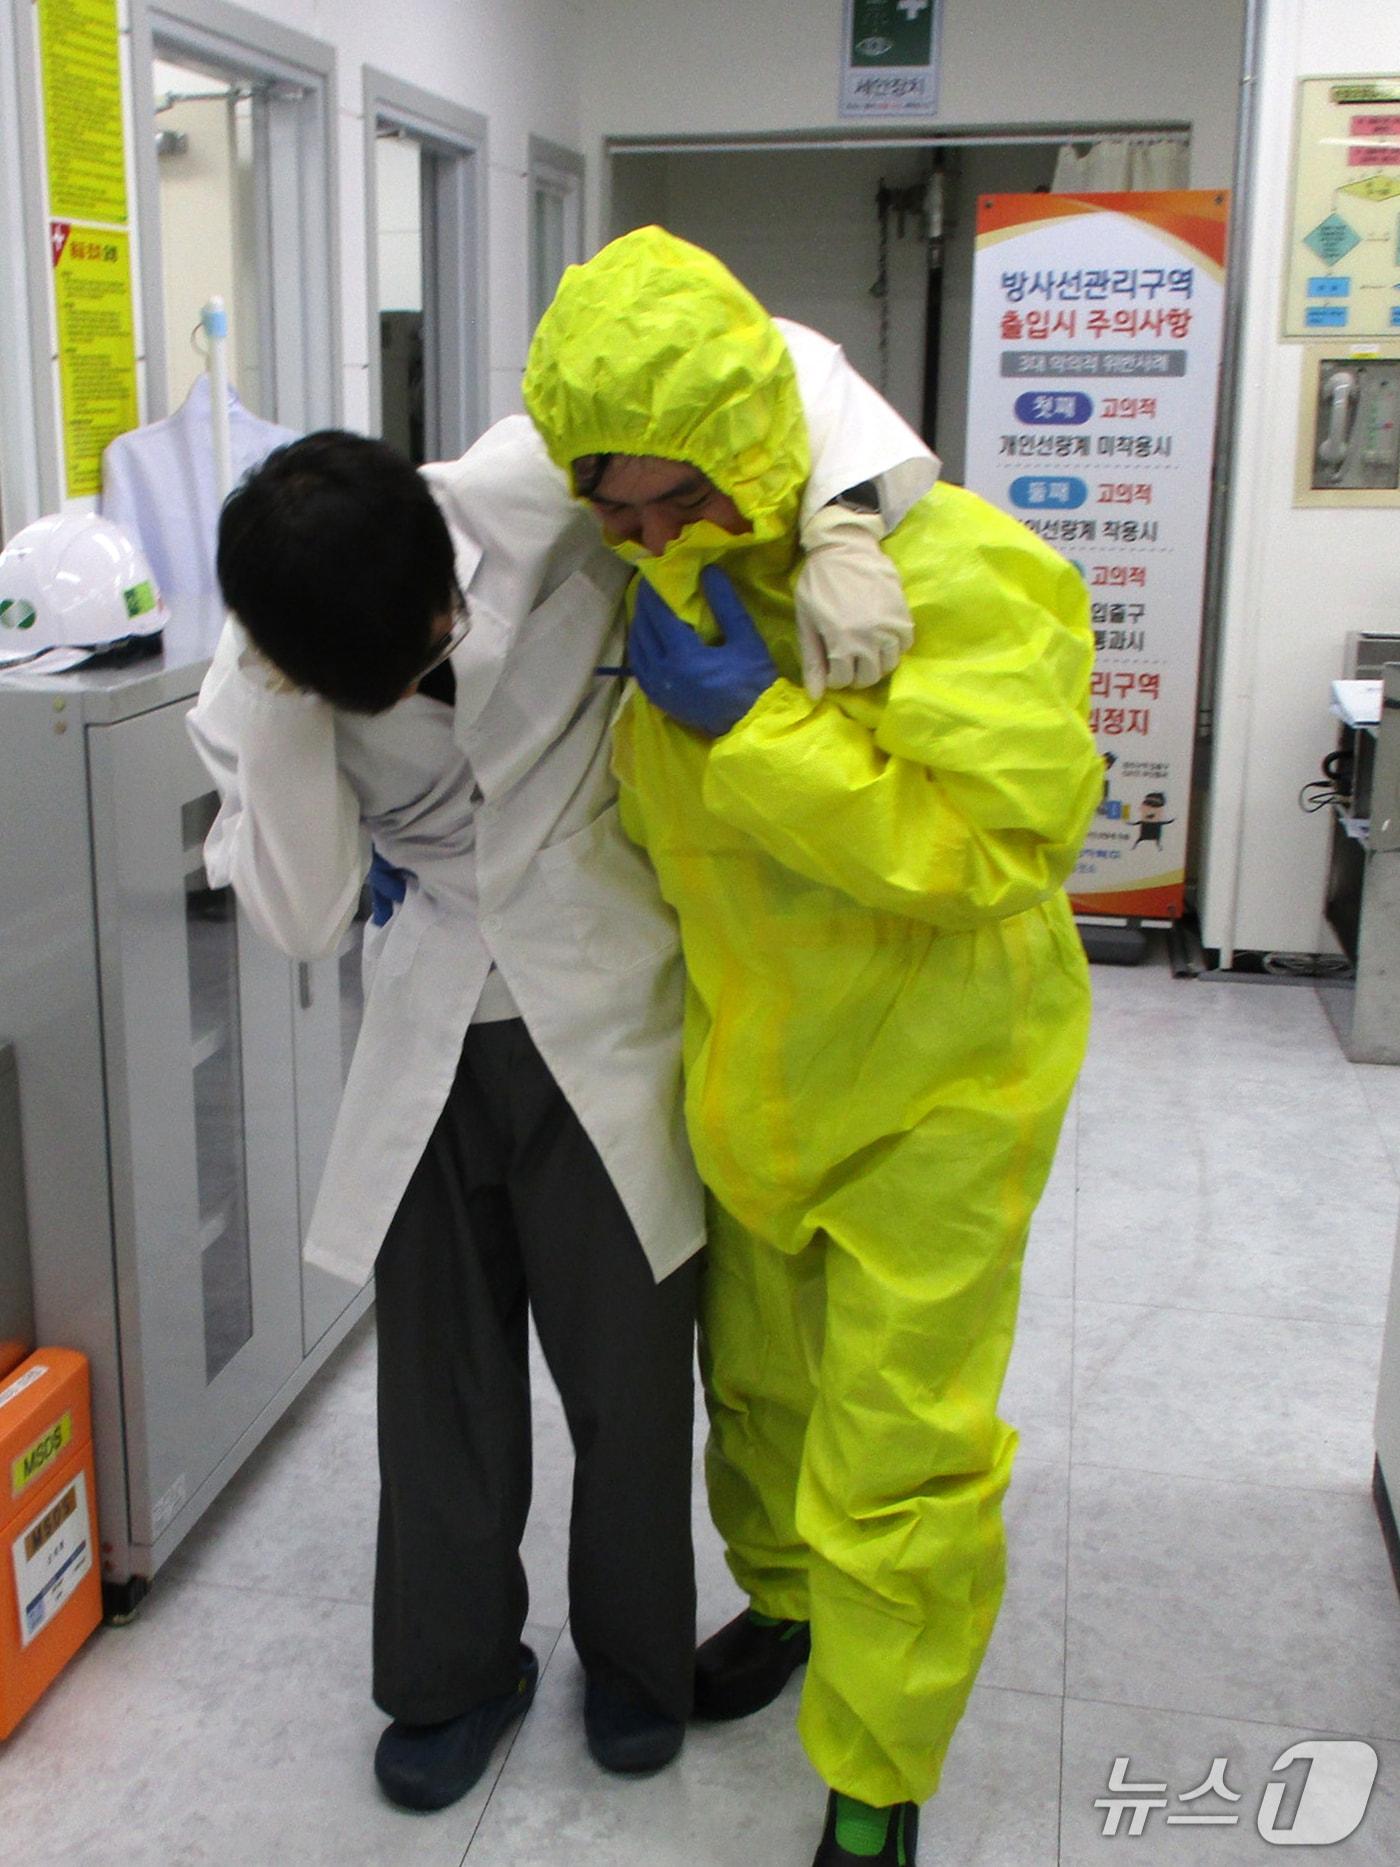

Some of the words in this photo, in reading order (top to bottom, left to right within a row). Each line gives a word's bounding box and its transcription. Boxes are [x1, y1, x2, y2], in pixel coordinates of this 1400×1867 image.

[1001, 267, 1194, 302] 방사선관리구역
[1000, 308, 1076, 340] 출입시
[1086, 308, 1192, 339] 주의사항
[1032, 395, 1077, 419] 첫째
[1099, 398, 1157, 419] 고의적
[999, 434, 1092, 457] 개인선량계
[1096, 434, 1172, 457] 미착용시
[1096, 483, 1153, 504] 고의적
[1102, 519, 1159, 543] 착용시
[1090, 566, 1147, 587] 고의적
